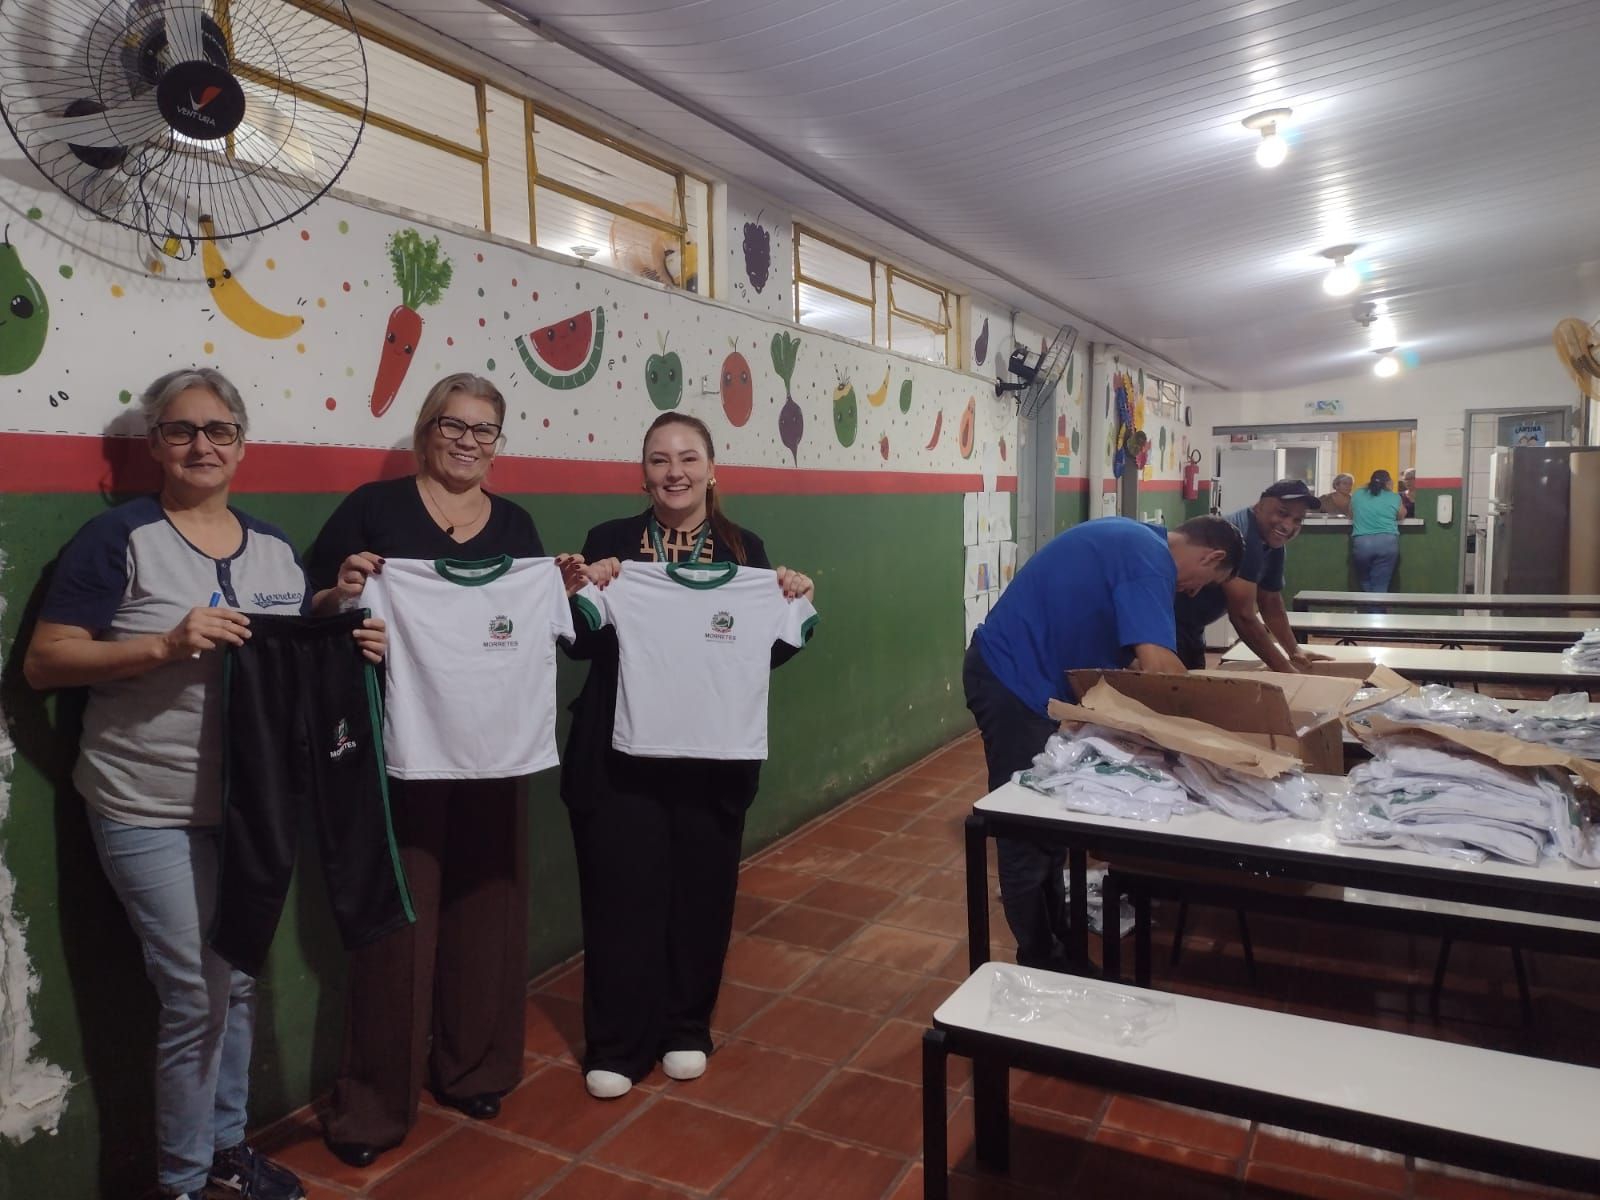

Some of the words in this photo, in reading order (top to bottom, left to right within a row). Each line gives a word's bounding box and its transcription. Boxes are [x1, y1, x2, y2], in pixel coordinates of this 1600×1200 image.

[176, 104, 216, 128] VENTURA
[252, 591, 302, 603] Morretes
[704, 632, 737, 641] MORRETES
[483, 640, 519, 648] MORRETES
